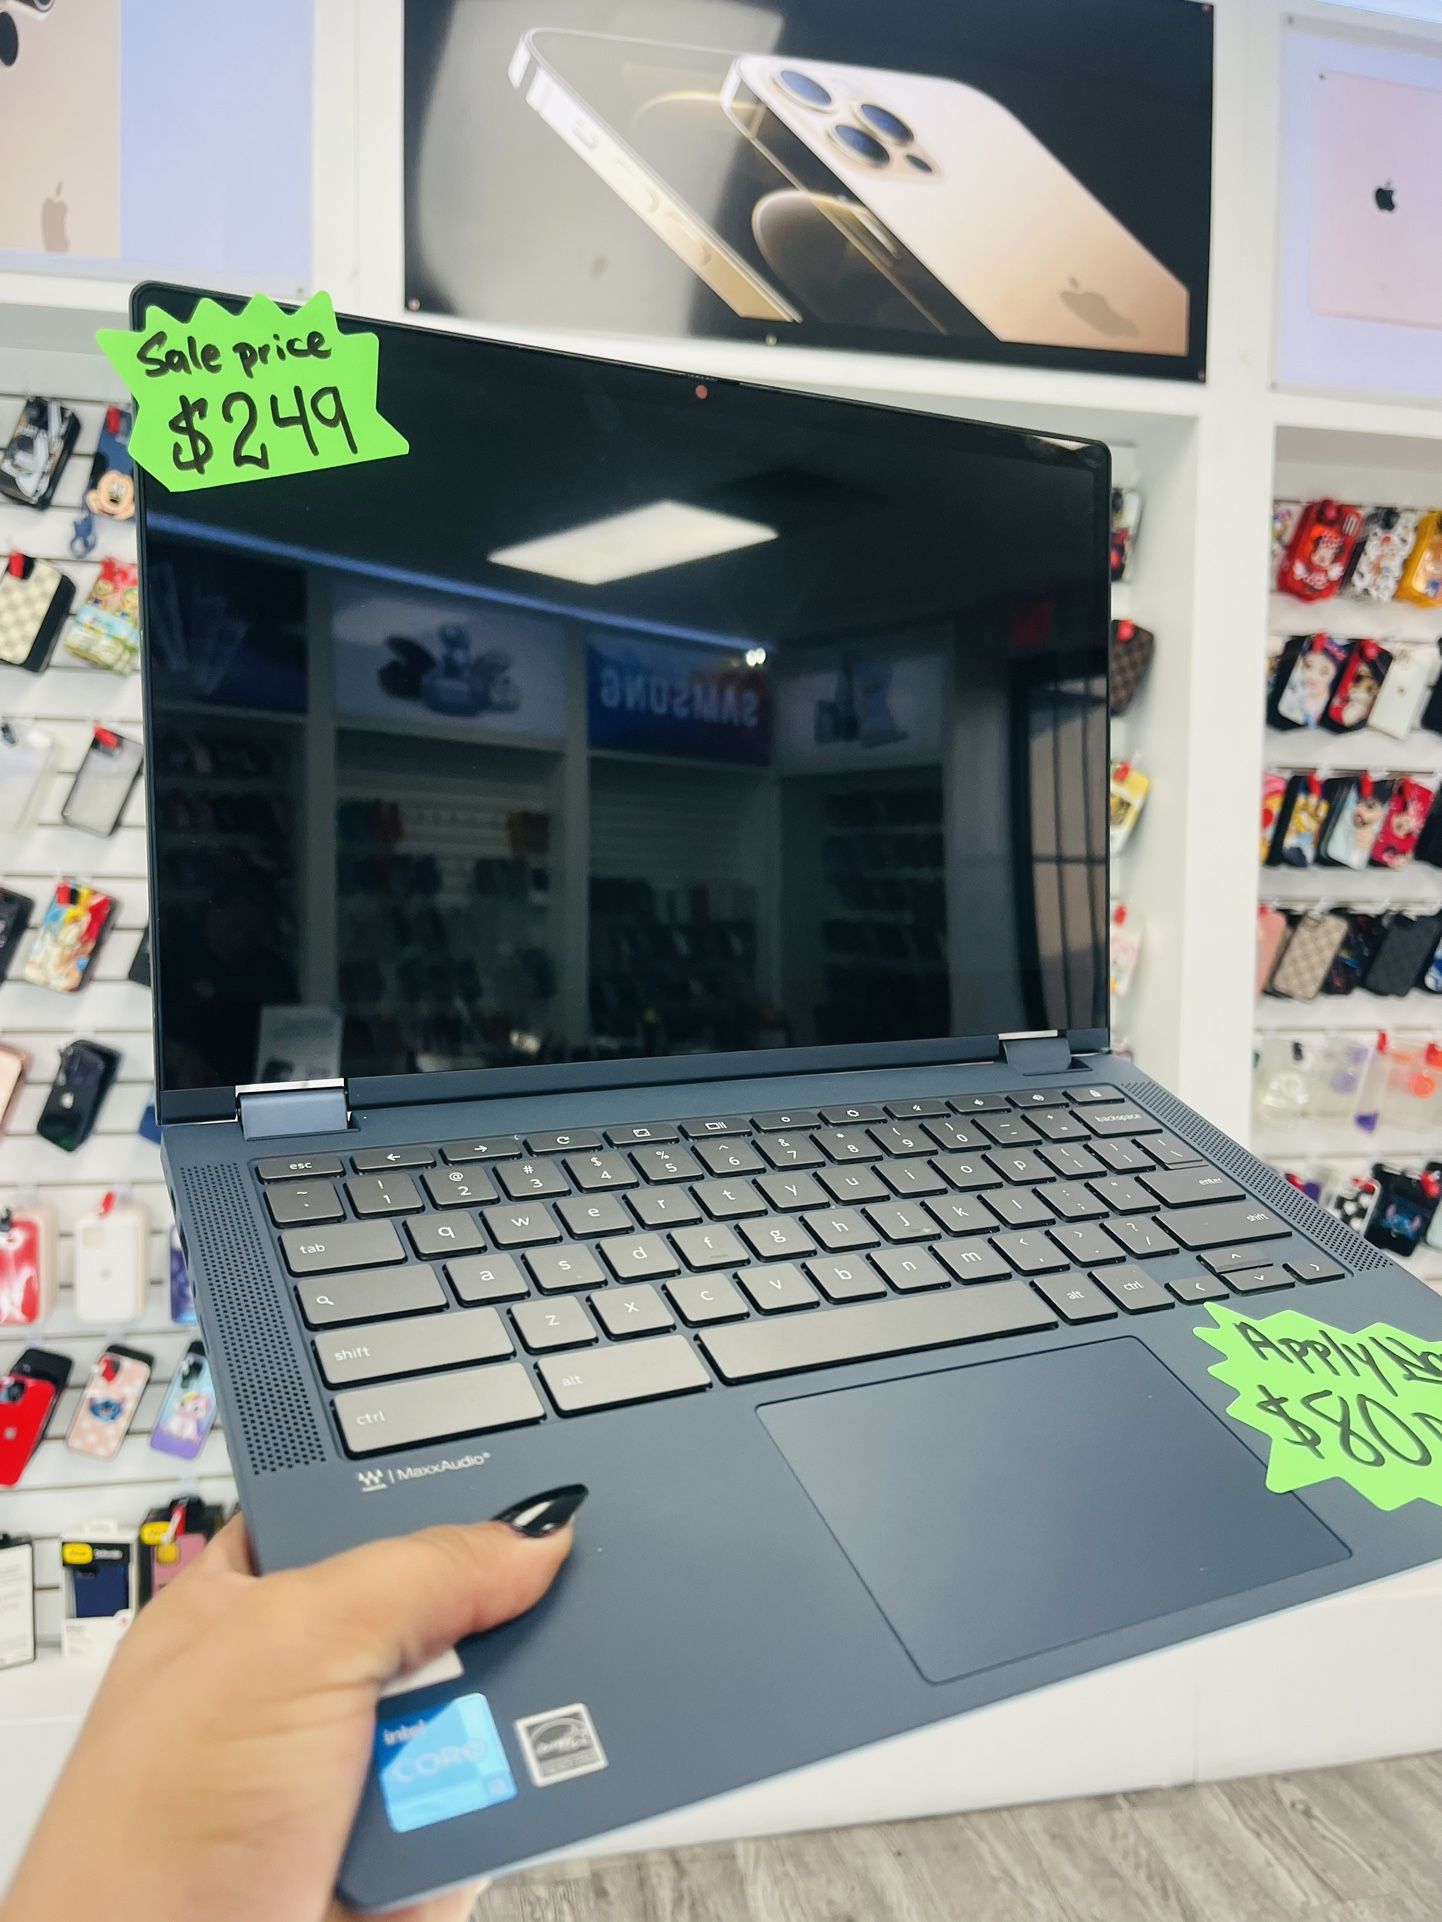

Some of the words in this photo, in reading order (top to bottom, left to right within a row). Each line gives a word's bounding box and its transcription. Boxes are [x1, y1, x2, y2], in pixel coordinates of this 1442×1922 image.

[136, 330, 223, 378] Sale
[232, 331, 332, 379] price
[169, 385, 359, 475] $249
[1094, 1113, 1142, 1122] backspace
[289, 1162, 312, 1170] esc
[1198, 1177, 1223, 1185] enter
[1246, 1213, 1269, 1222] shift
[299, 1243, 326, 1254] tab
[1123, 1280, 1144, 1291] ctrl
[1066, 1290, 1085, 1300] alt
[334, 1346, 370, 1361] shift
[1231, 1321, 1398, 1397] Apply
[1367, 1336, 1442, 1385] No
[561, 1375, 583, 1387] alt
[356, 1410, 385, 1425] ctrl
